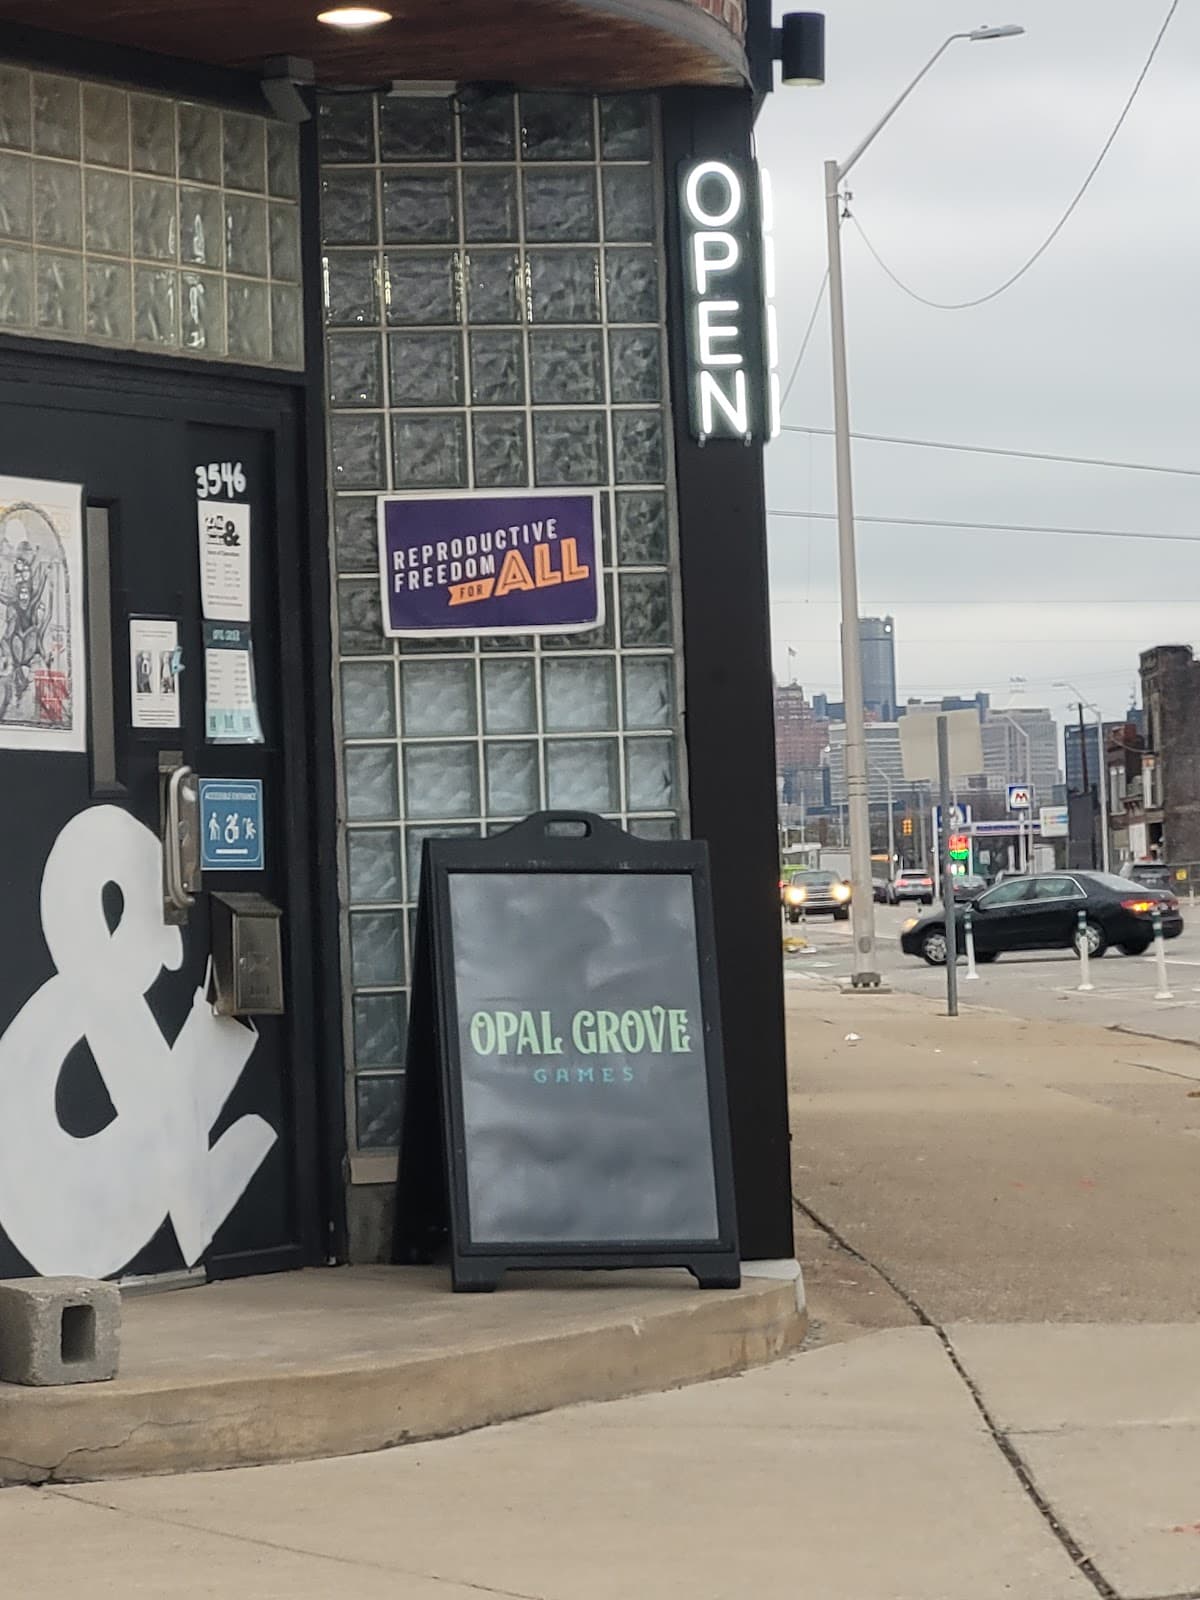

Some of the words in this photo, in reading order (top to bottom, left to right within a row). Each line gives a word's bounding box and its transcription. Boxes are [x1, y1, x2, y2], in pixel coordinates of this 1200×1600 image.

[686, 161, 748, 434] OPEN
[195, 462, 247, 498] 3546
[393, 518, 558, 570] REPRODUCTIVE
[459, 584, 484, 599] FOR
[494, 537, 589, 596] ALL
[394, 554, 495, 593] FREEDOM
[470, 1010, 564, 1055] OPAL
[572, 1005, 692, 1054] GROVE
[533, 1066, 634, 1084] GAMES
